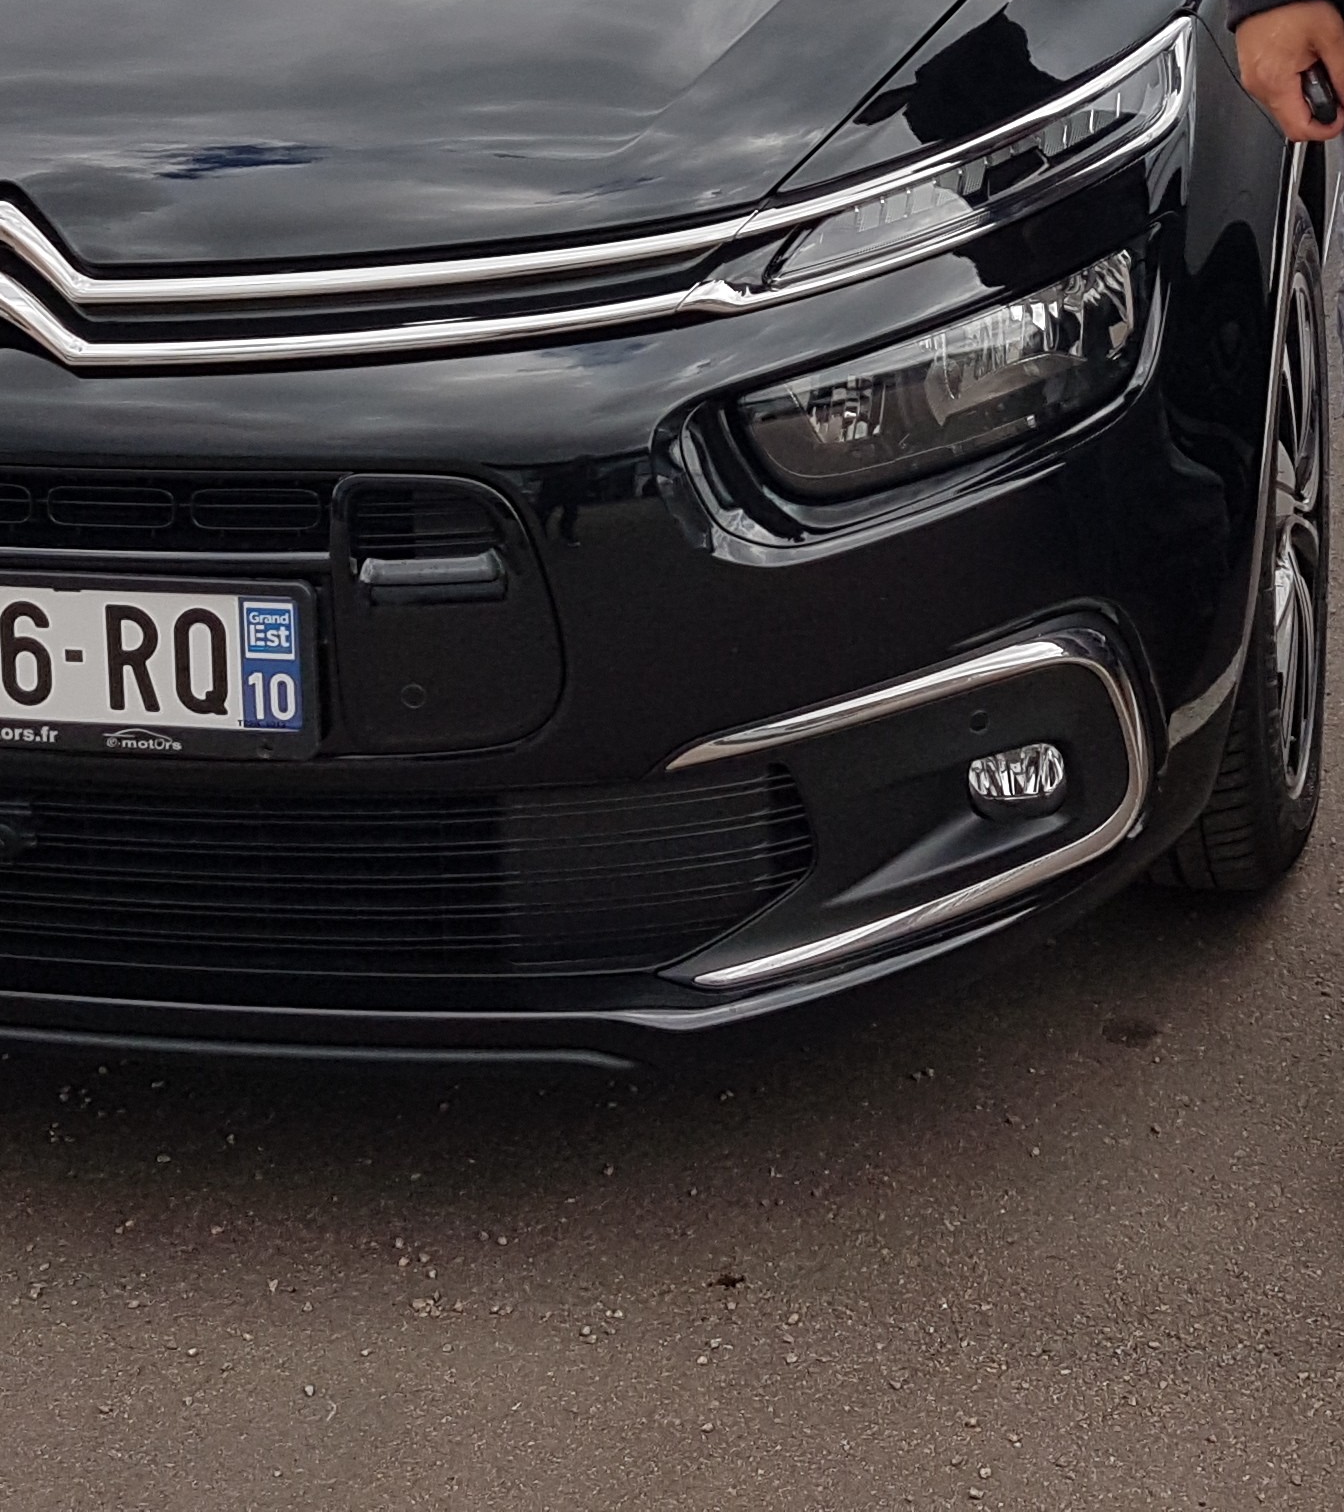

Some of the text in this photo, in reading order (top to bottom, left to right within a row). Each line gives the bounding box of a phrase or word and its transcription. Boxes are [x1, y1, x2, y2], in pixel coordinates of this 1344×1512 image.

[249, 611, 289, 625] Grand
[249, 624, 290, 648] Est
[247, 671, 296, 721] 10
